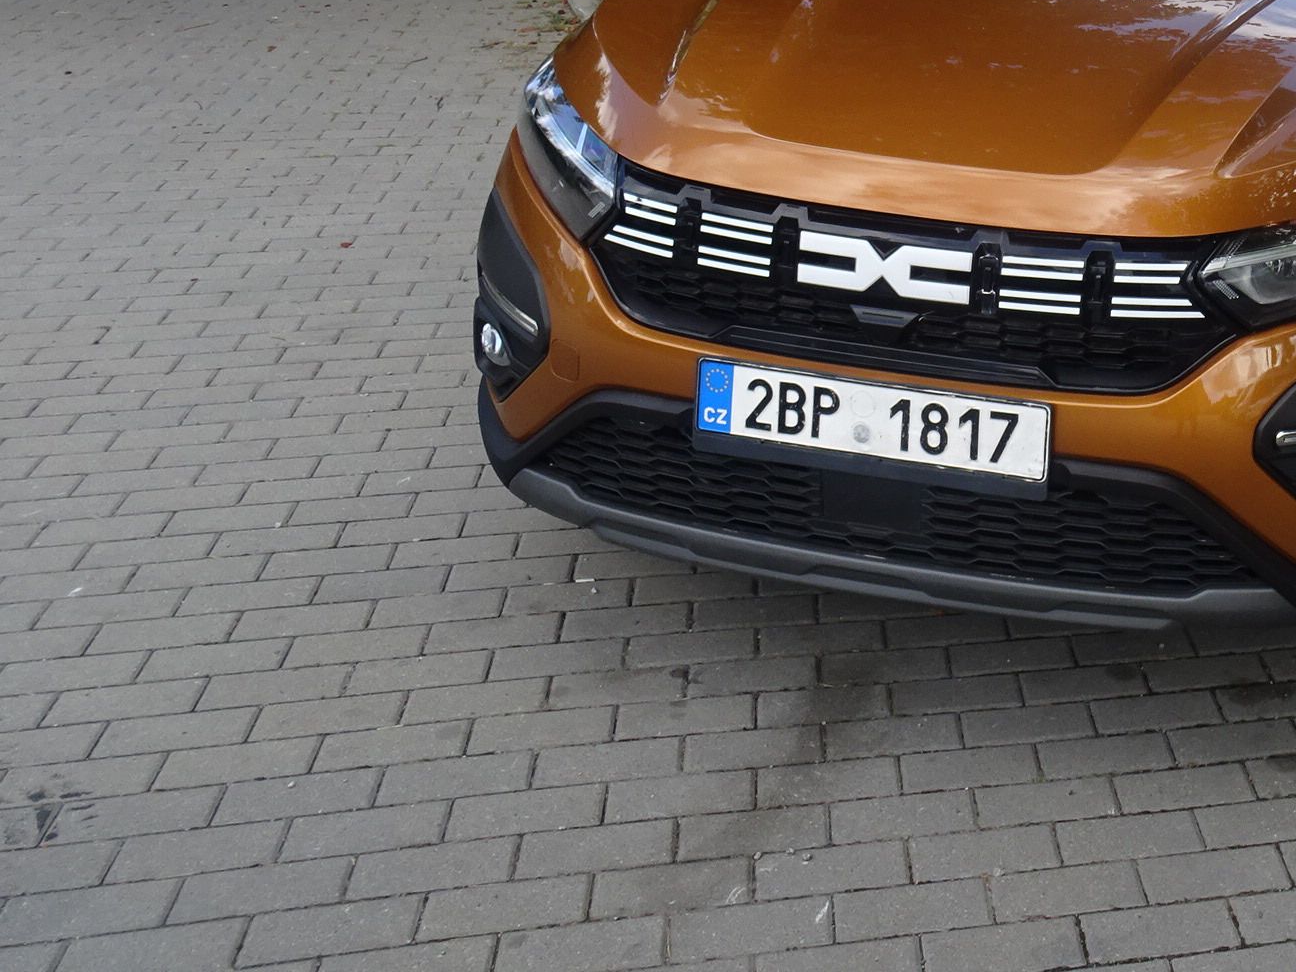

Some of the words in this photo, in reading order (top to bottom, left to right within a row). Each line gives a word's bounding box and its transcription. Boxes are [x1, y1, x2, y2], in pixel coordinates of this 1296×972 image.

[703, 406, 728, 425] CZ
[745, 378, 840, 438] 2BP
[890, 399, 1019, 463] 1817
